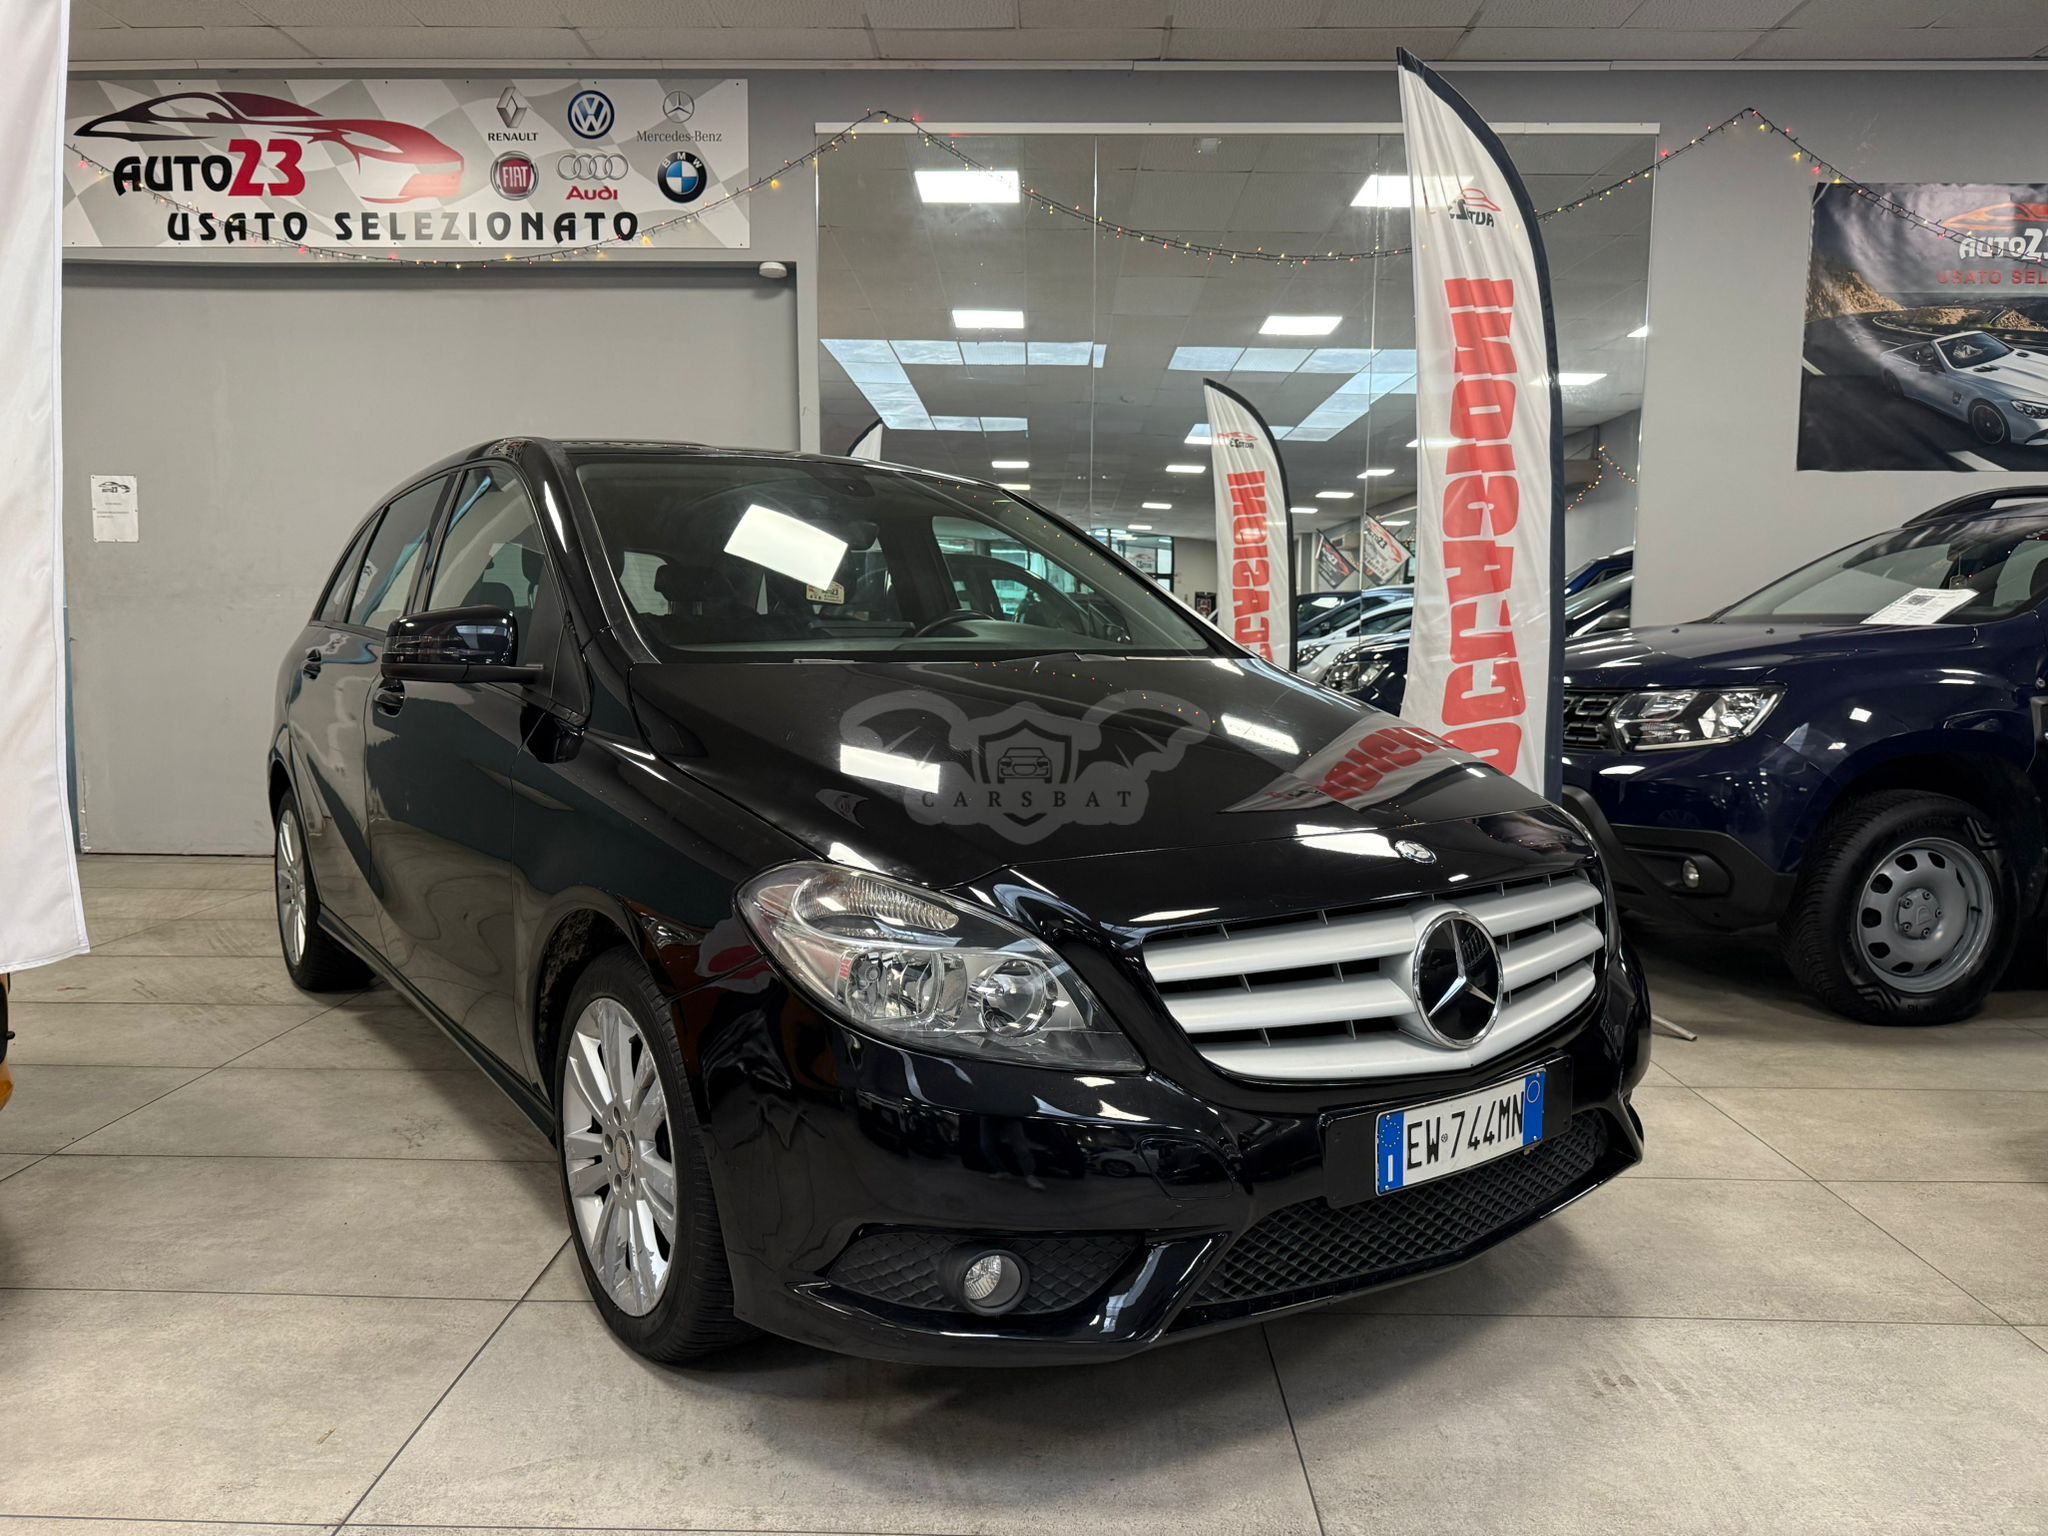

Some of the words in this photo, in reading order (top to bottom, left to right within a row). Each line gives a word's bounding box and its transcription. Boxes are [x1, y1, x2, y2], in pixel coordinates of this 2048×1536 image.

[488, 132, 538, 141] RENAULT
[637, 131, 722, 142] Mercedes-Benz
[114, 139, 306, 196] AUTO23
[662, 151, 702, 168] BMW
[502, 166, 528, 188] FIAT
[566, 185, 618, 200] Audi
[168, 212, 308, 244] USATO
[335, 211, 638, 244] SELEZIONATO
[1959, 228, 2048, 260] AUTO2
[1938, 271, 2003, 285] USATO
[1406, 1116, 1441, 1170] EW
[1451, 1091, 1525, 1158] 744MN
